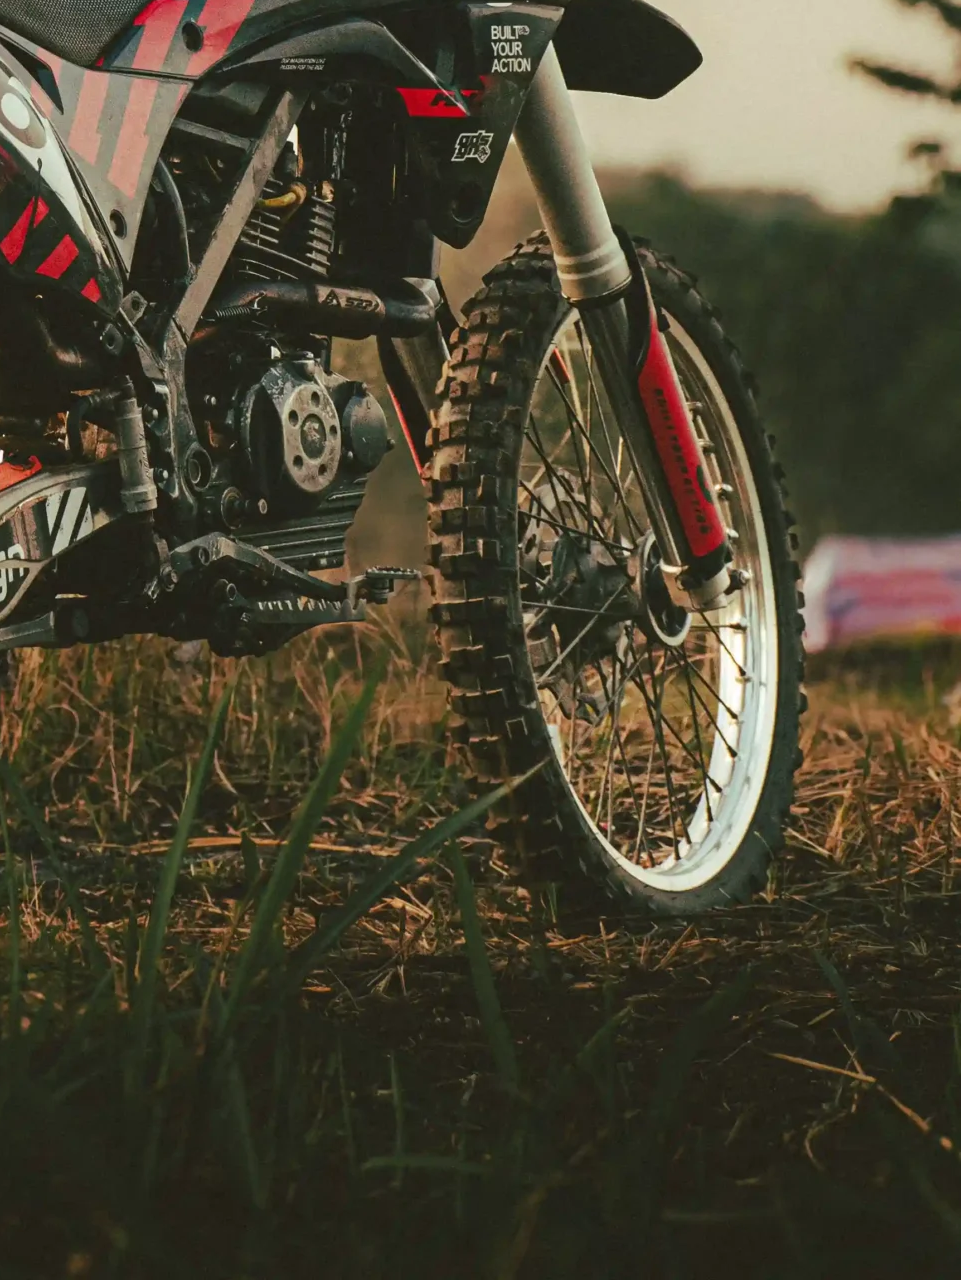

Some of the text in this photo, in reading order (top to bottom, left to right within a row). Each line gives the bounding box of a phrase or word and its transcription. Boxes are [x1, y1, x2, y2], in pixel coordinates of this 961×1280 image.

[490, 25, 519, 40] BUILT
[491, 41, 523, 56] YOUR
[491, 57, 531, 73] ACTION
